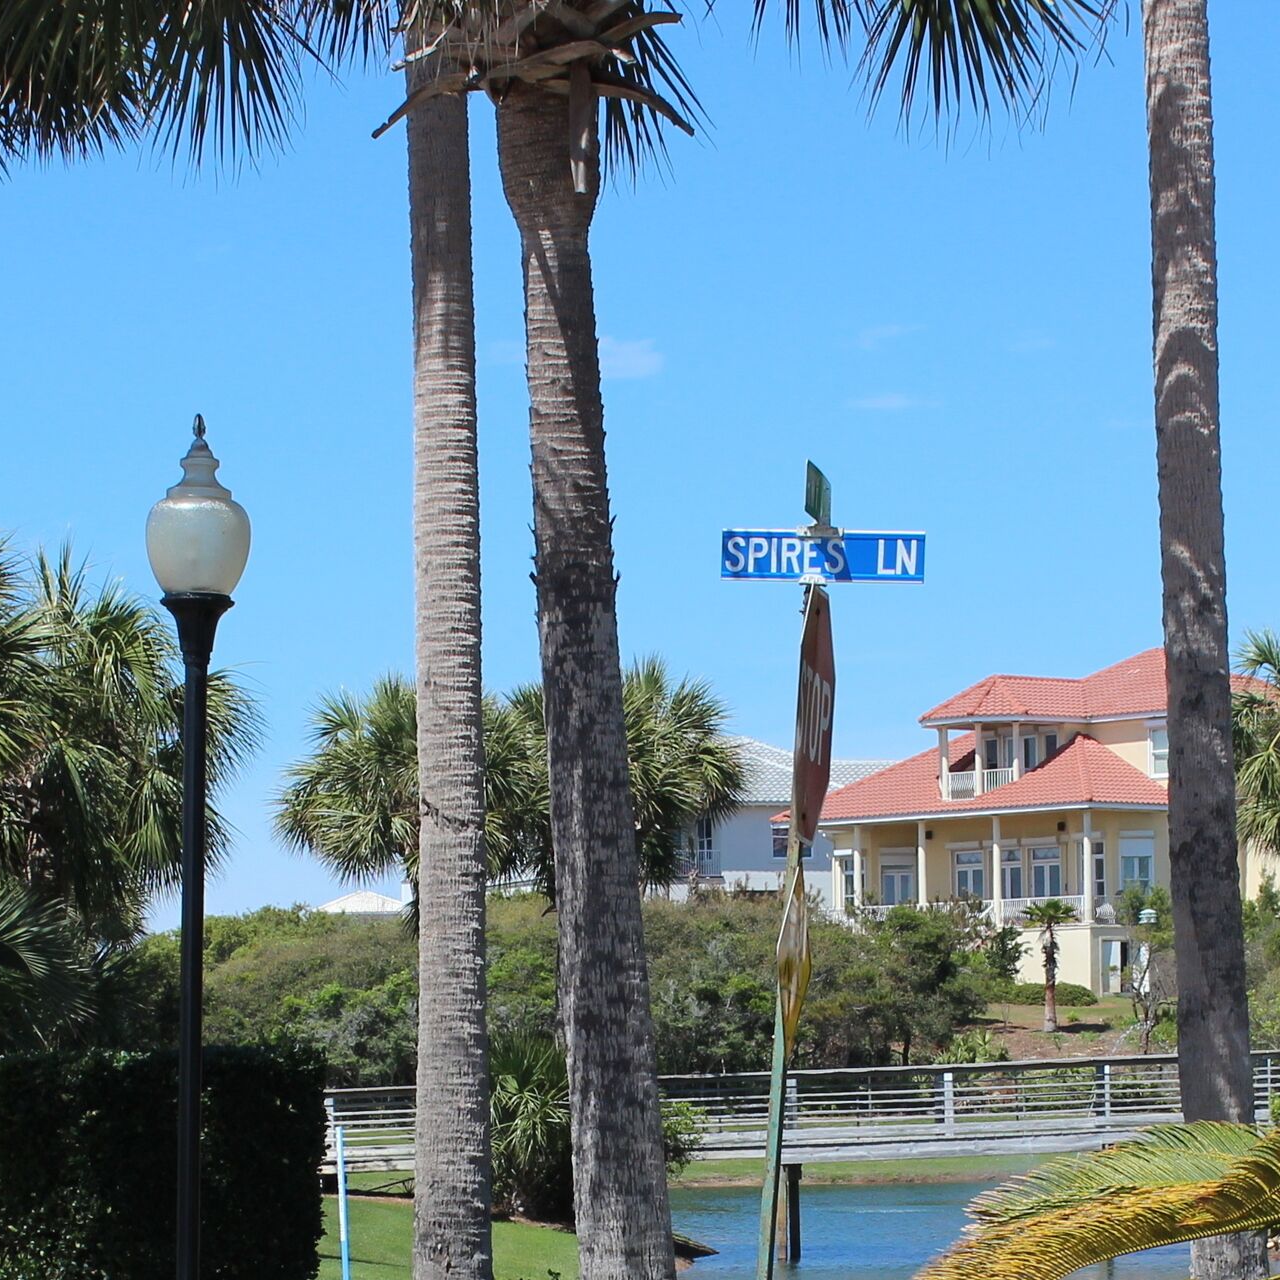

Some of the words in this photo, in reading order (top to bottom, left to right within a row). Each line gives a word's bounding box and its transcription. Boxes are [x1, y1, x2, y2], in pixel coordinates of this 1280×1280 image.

[725, 536, 845, 574] SPIRES
[877, 539, 917, 575] LN
[796, 659, 831, 766] STOP
